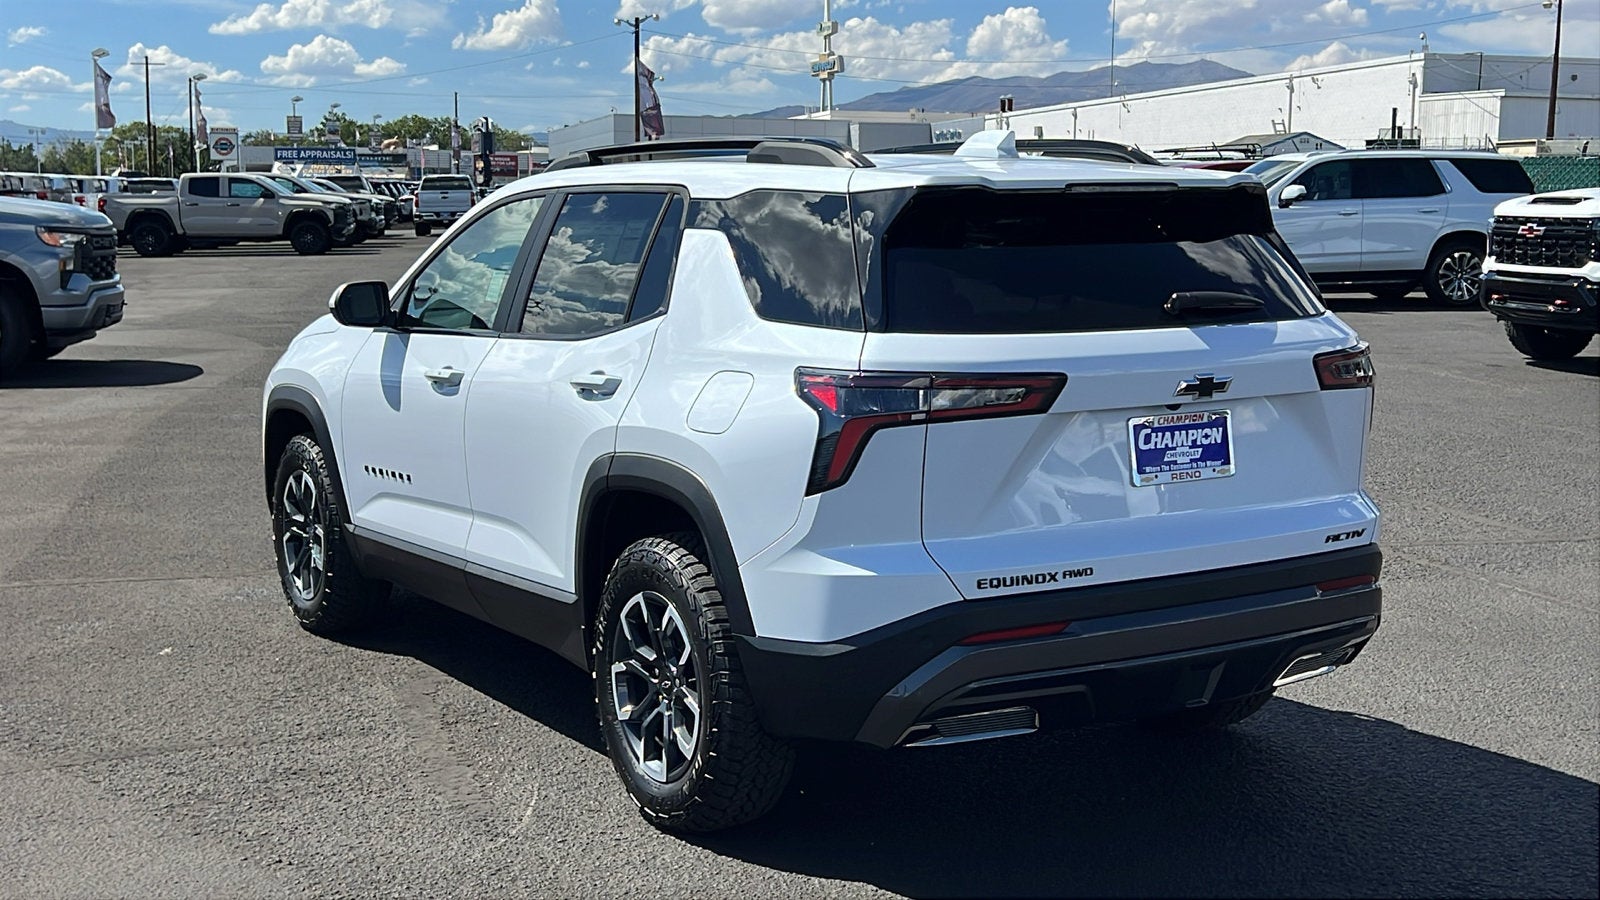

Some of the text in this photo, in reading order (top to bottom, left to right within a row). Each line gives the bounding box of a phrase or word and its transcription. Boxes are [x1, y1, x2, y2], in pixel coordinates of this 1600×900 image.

[277, 150, 298, 159] FREE
[300, 150, 354, 159] APPRAISALS!
[1158, 413, 1204, 425] CHAMPION
[1138, 427, 1223, 450] CHAMPION
[1166, 450, 1200, 459] CHEVROLET
[1171, 470, 1202, 481] RENO
[976, 566, 1094, 590] EQUINOX AWD
